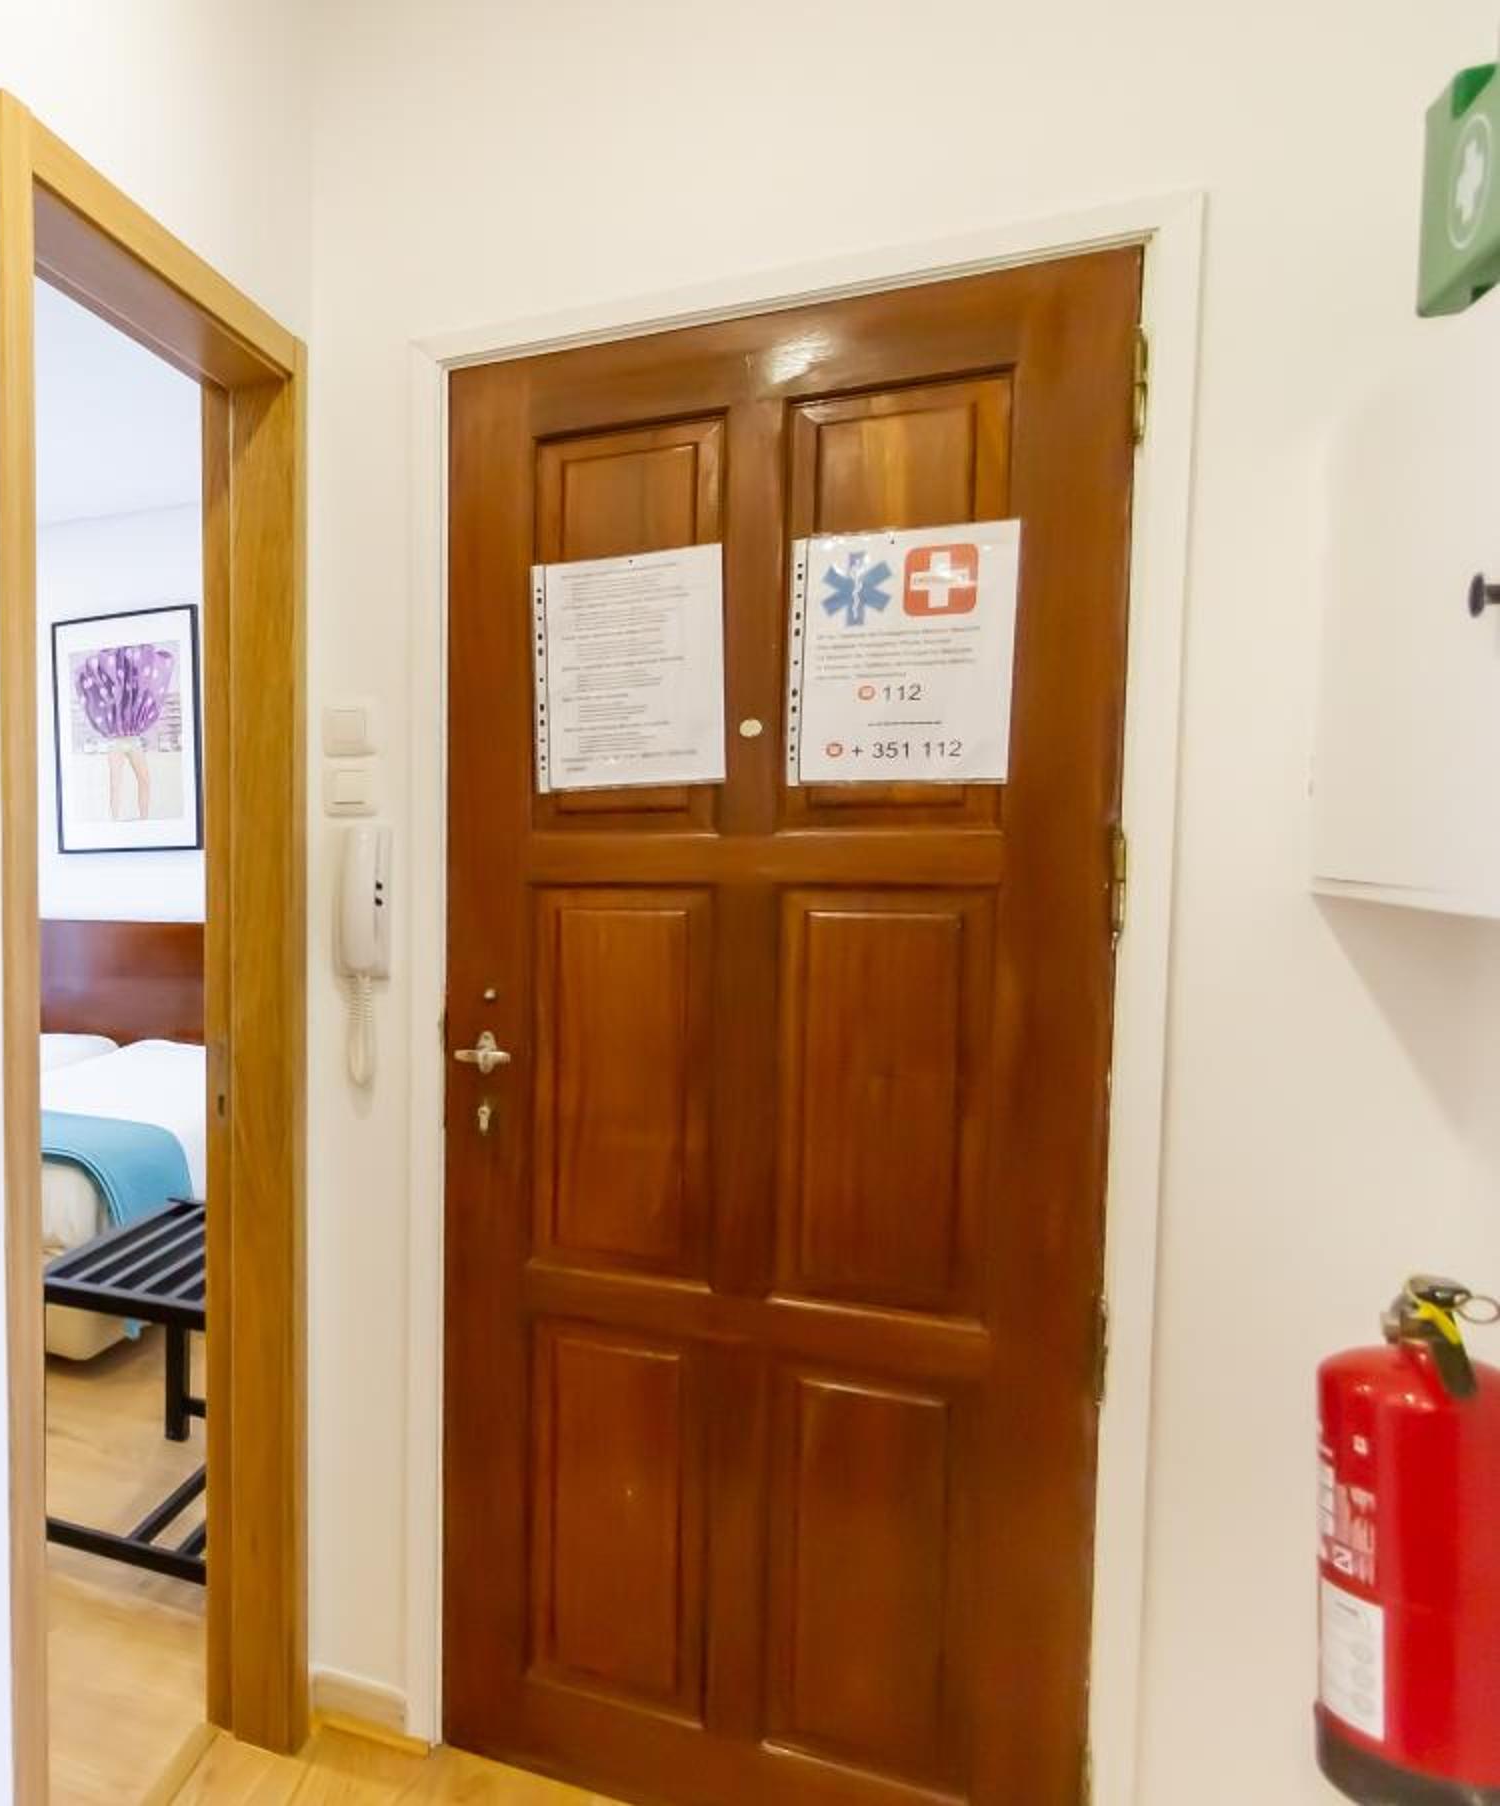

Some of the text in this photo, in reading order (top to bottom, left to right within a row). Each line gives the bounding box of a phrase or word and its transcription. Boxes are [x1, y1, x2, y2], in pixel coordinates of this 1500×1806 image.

[883, 684, 922, 701] 112
[872, 741, 910, 759] 351
[924, 740, 963, 757] 112
